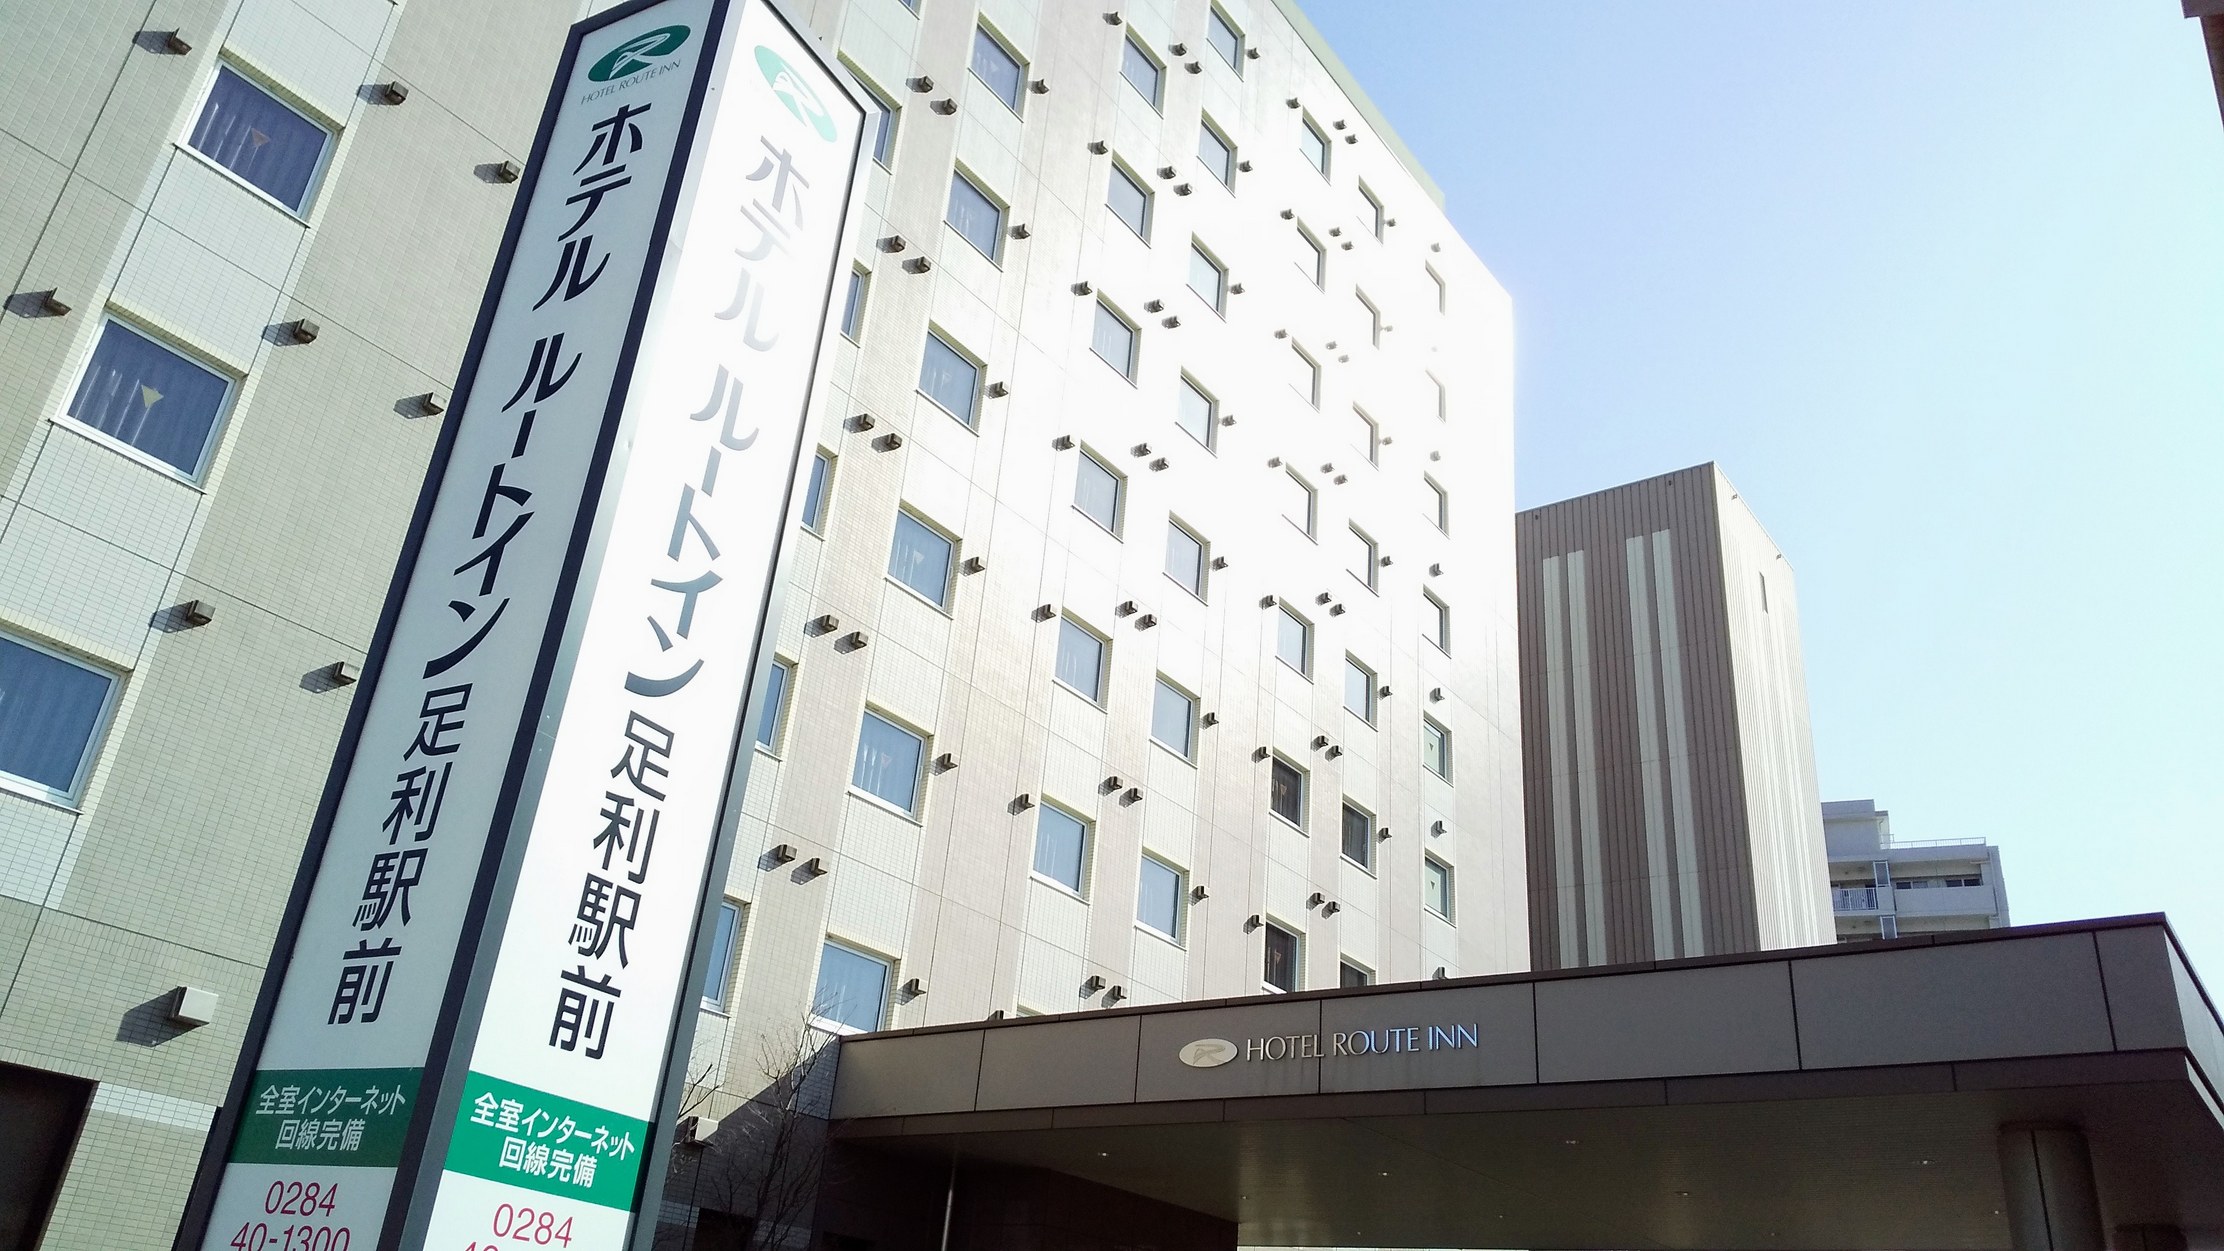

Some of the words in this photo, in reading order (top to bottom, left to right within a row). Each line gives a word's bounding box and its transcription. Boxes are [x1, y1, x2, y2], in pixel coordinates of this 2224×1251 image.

[581, 84, 616, 105] HOTEL
[618, 69, 656, 91] ROUTE
[658, 59, 681, 79] INN
[532, 103, 652, 312] ホテル
[714, 135, 810, 352] ホテル
[327, 333, 583, 1025] ルートイン足利駅前
[548, 363, 759, 1060] ルートイン足利駅前
[1246, 1034, 1325, 1061] HOTEL
[1333, 1027, 1420, 1056] ROUTE
[1428, 1023, 1479, 1050] INN
[255, 1084, 406, 1116] 全室インターネット
[274, 1118, 365, 1152] 回線完備
[469, 1091, 635, 1162] 全室インターネット
[498, 1137, 599, 1189] 回線完備
[265, 1180, 338, 1217] 0284
[230, 1222, 350, 1251] 40-1300
[493, 1203, 573, 1248] 0284
